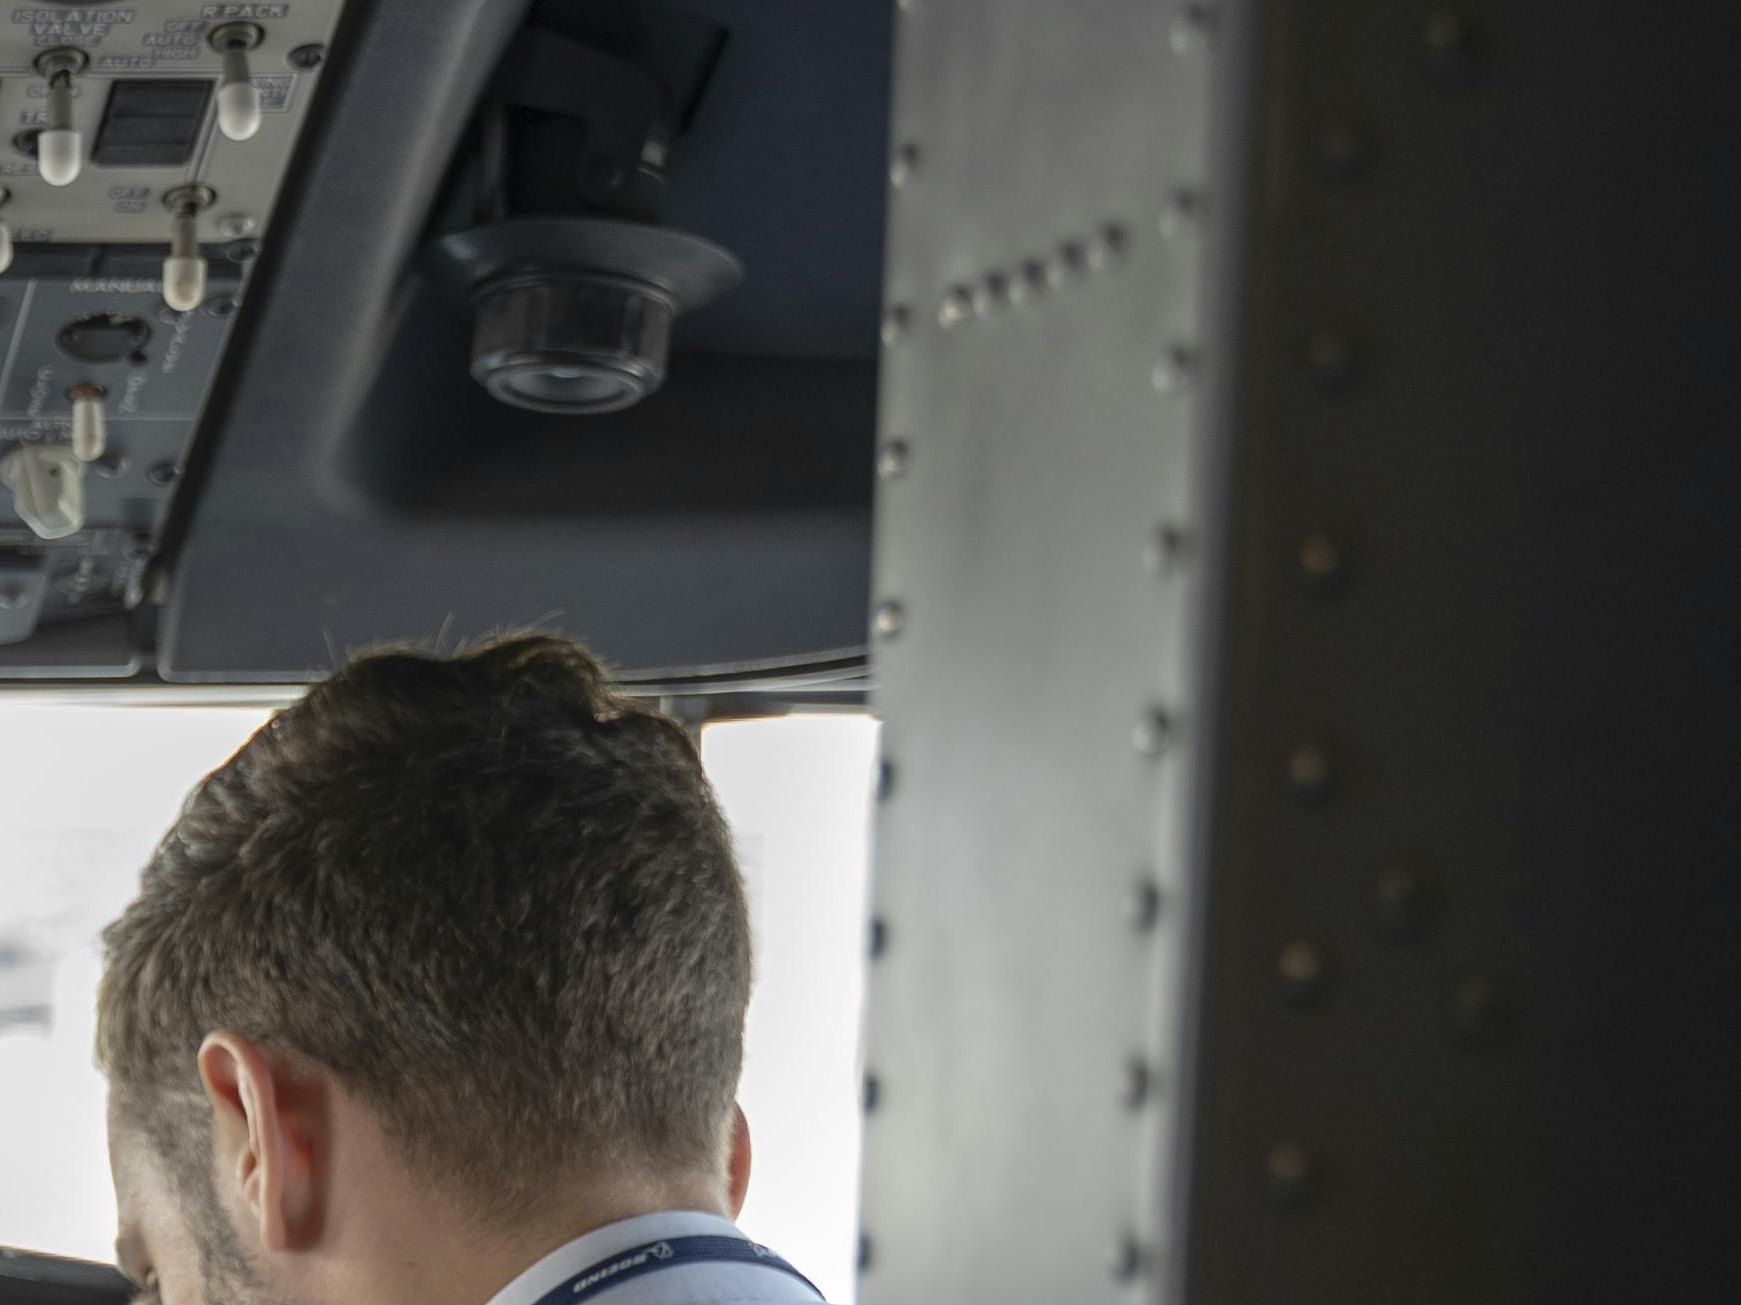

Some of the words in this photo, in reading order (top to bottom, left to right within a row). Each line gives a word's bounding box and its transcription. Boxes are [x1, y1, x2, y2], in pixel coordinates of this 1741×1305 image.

[13, 10, 135, 23] ISOLATION
[222, 5, 288, 18] PACK
[31, 23, 110, 36] VALVE
[142, 34, 199, 46] AUTO
[99, 56, 153, 69] AUTO
[70, 278, 162, 293] MANUA
